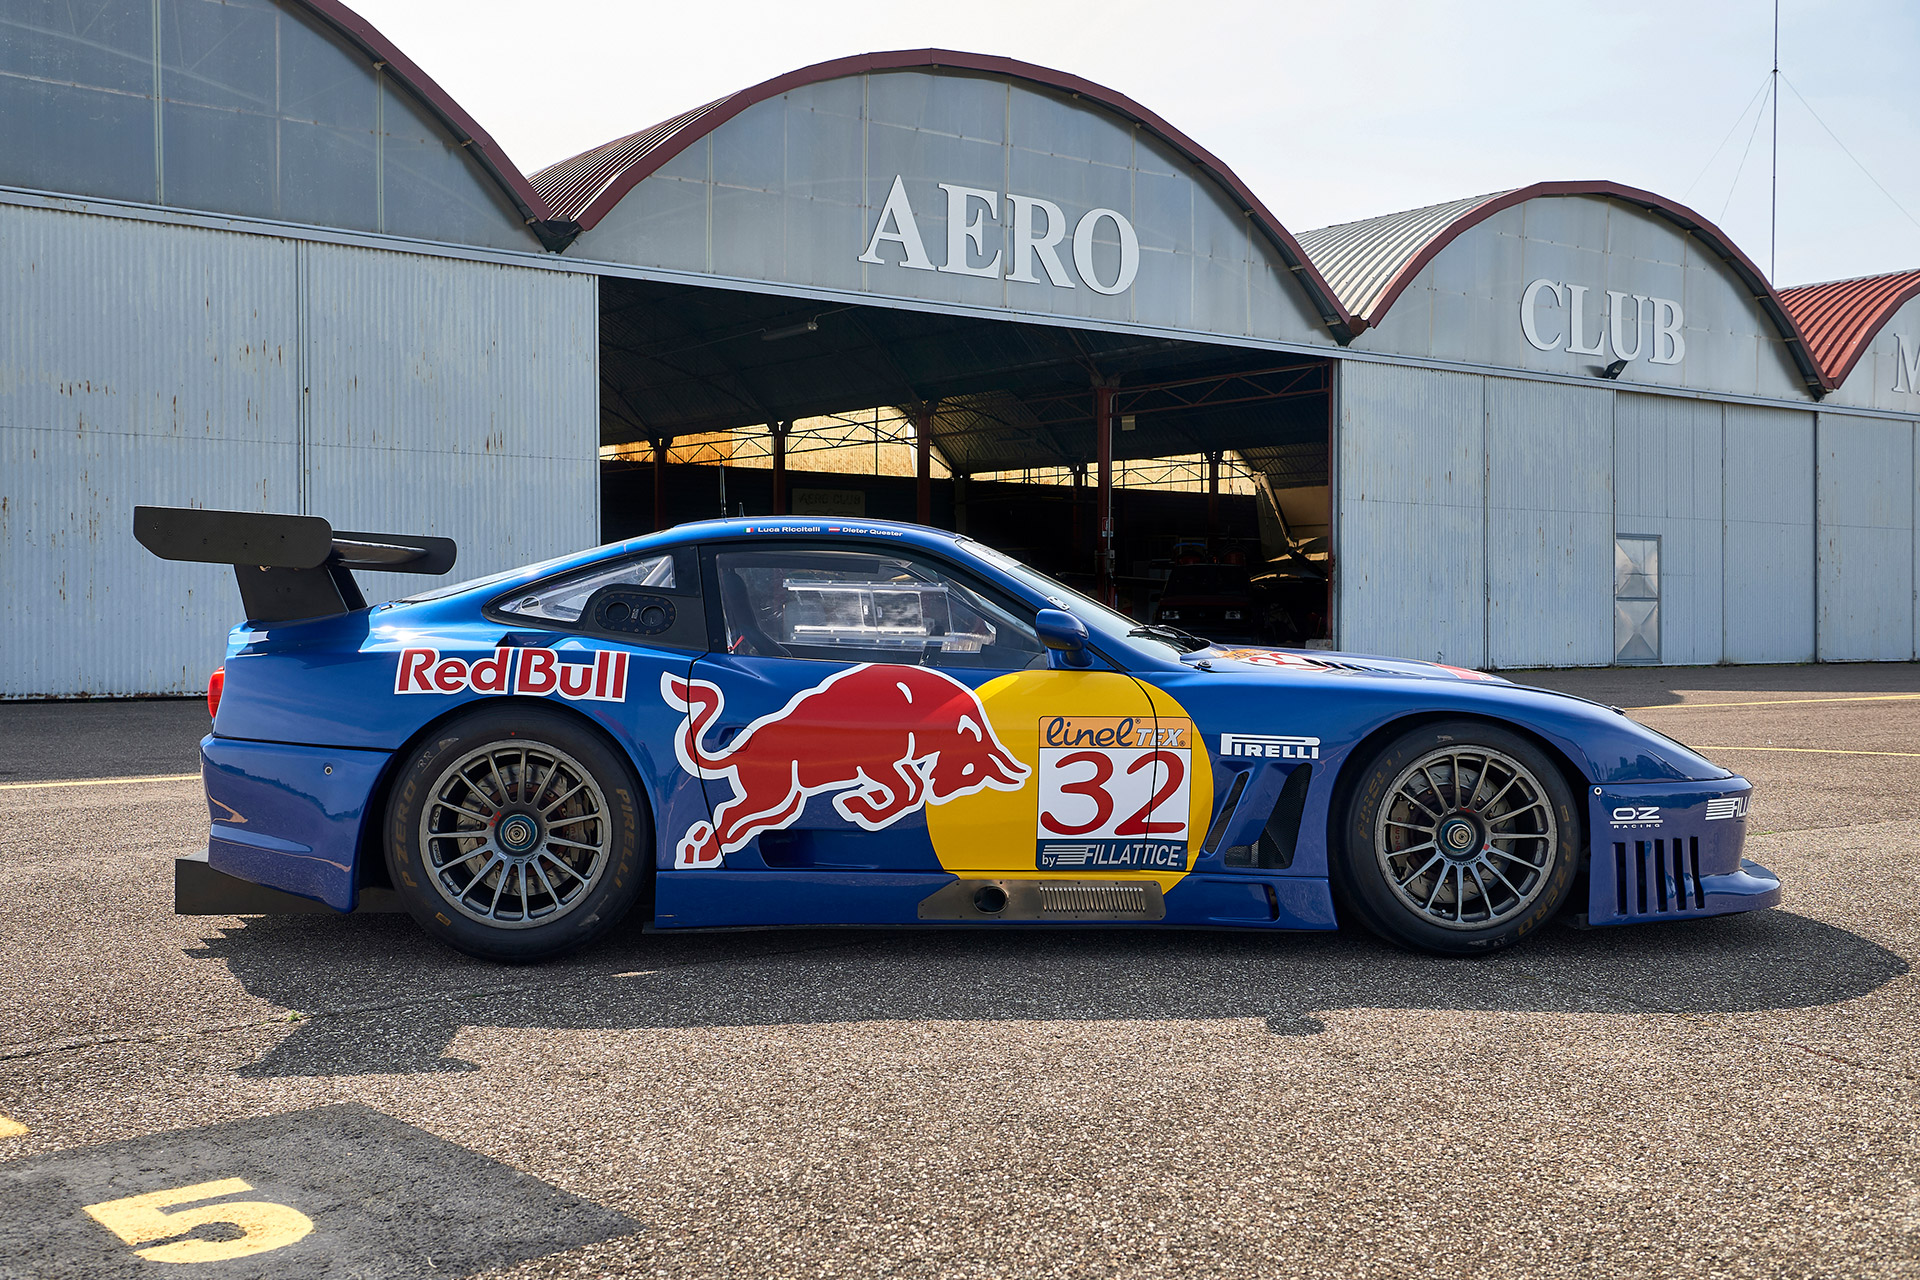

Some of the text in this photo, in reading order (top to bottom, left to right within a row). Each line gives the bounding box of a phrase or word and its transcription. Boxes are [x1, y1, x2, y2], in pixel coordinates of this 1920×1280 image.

[857, 174, 1140, 296] AERO
[1519, 278, 1687, 366] CLUB
[842, 527, 904, 537] Dieter Quester
[394, 647, 631, 703] Red Bull
[1220, 733, 1321, 760] PIRELLI
[1040, 751, 1186, 836] 32
[615, 788, 636, 889] PIRELLI
[1041, 844, 1182, 867] by FILLATTICE
[82, 1177, 315, 1264] 5
